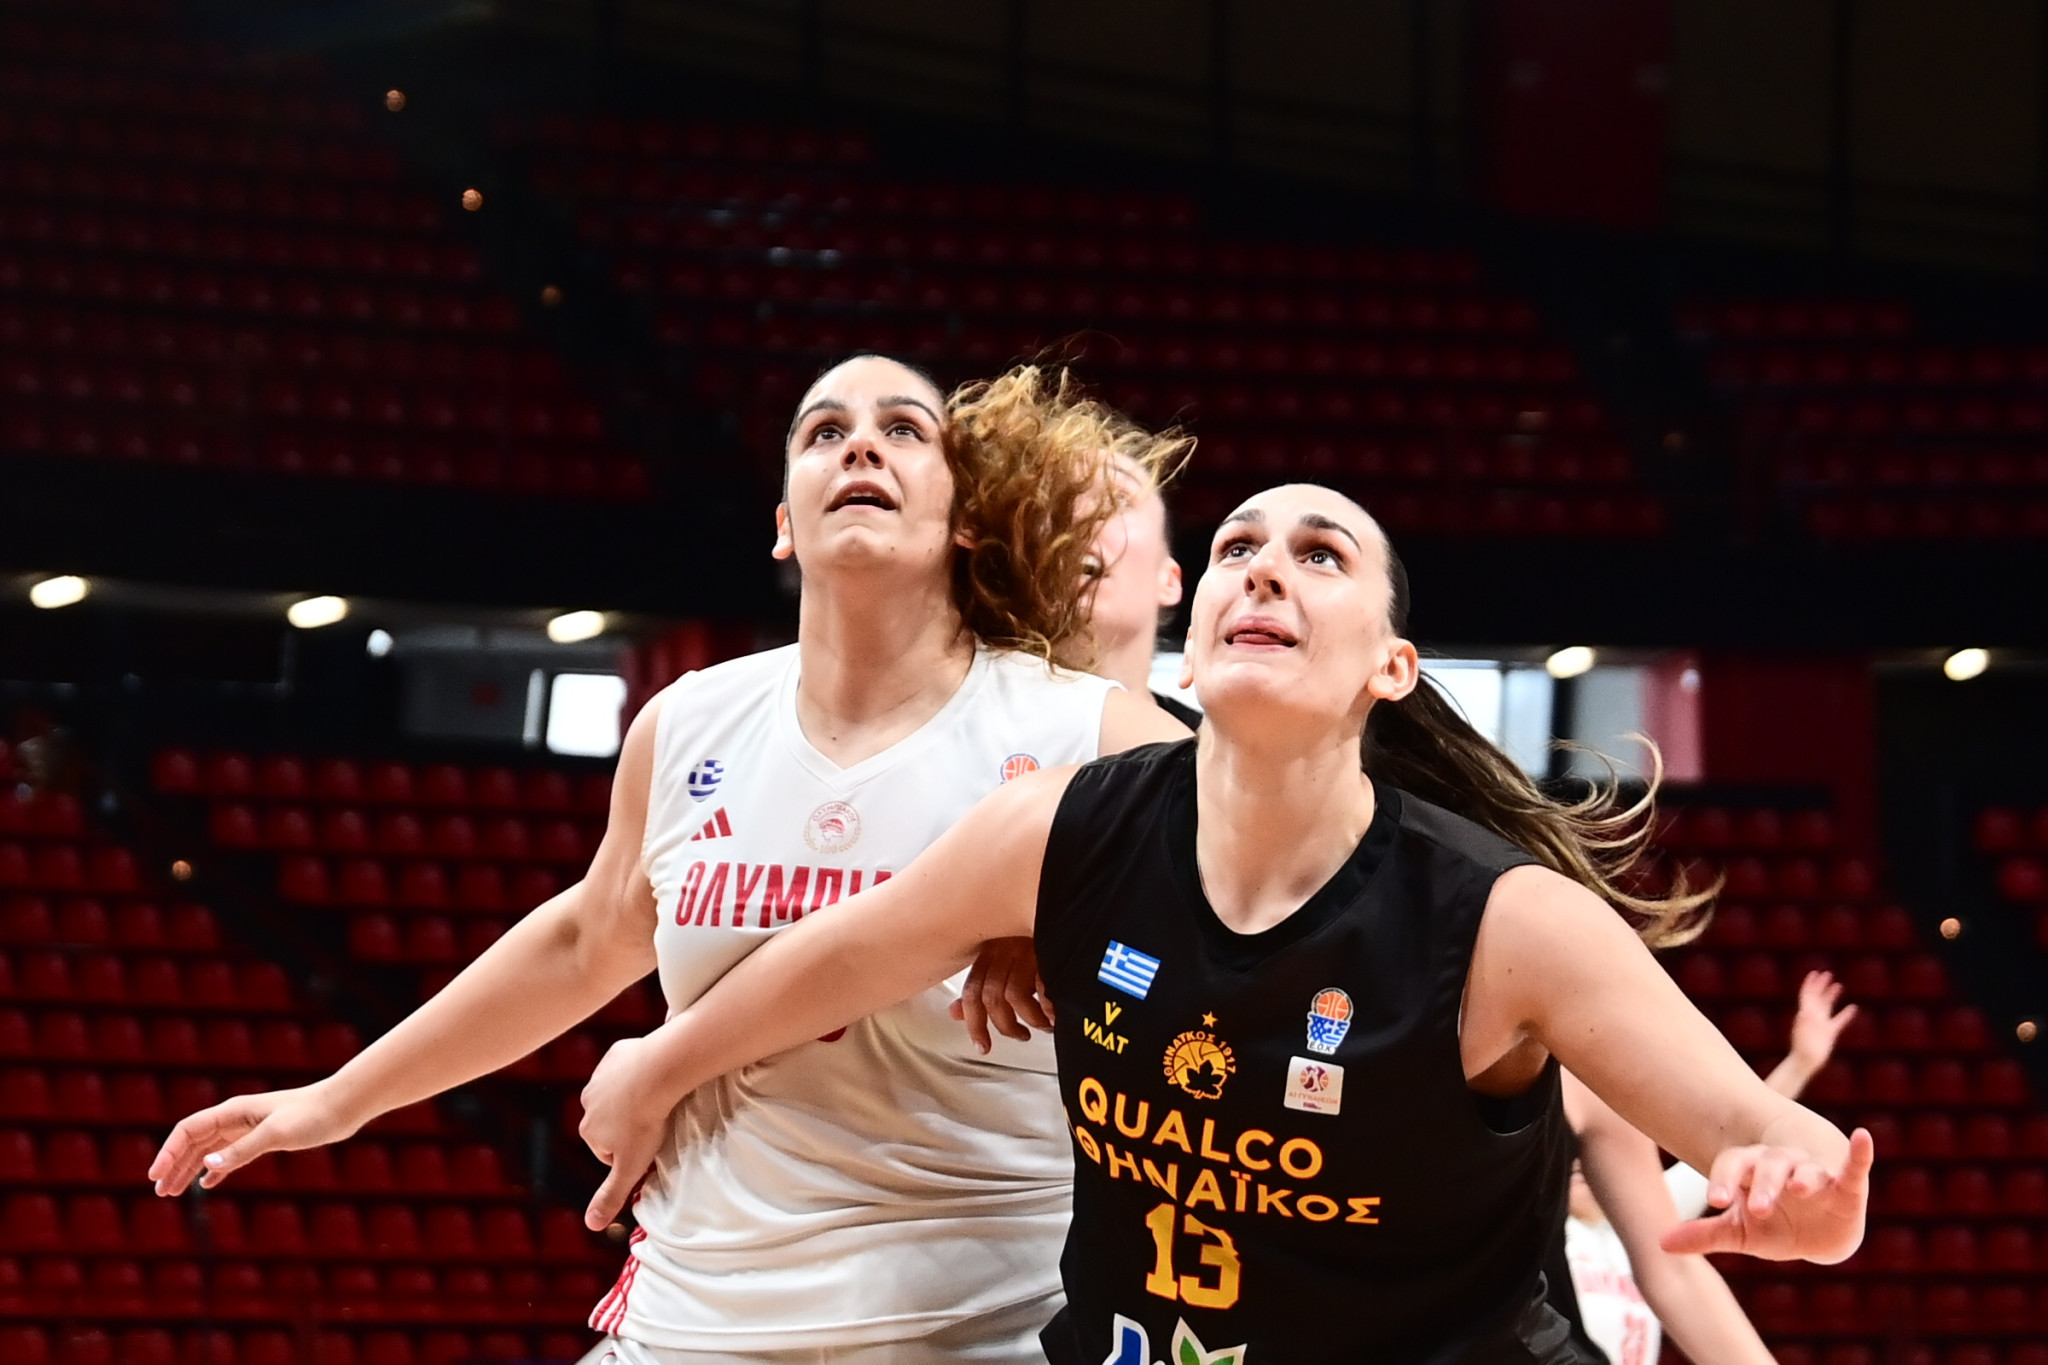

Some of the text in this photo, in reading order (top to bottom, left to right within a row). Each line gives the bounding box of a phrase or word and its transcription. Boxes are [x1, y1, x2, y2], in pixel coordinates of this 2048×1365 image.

[1219, 1041, 1236, 1074] 1917
[1064, 1105, 1381, 1224] ΘΗΝΑΪΚΟΣ
[1078, 1077, 1323, 1180] QUALCO
[1146, 1203, 1241, 1309] 13
